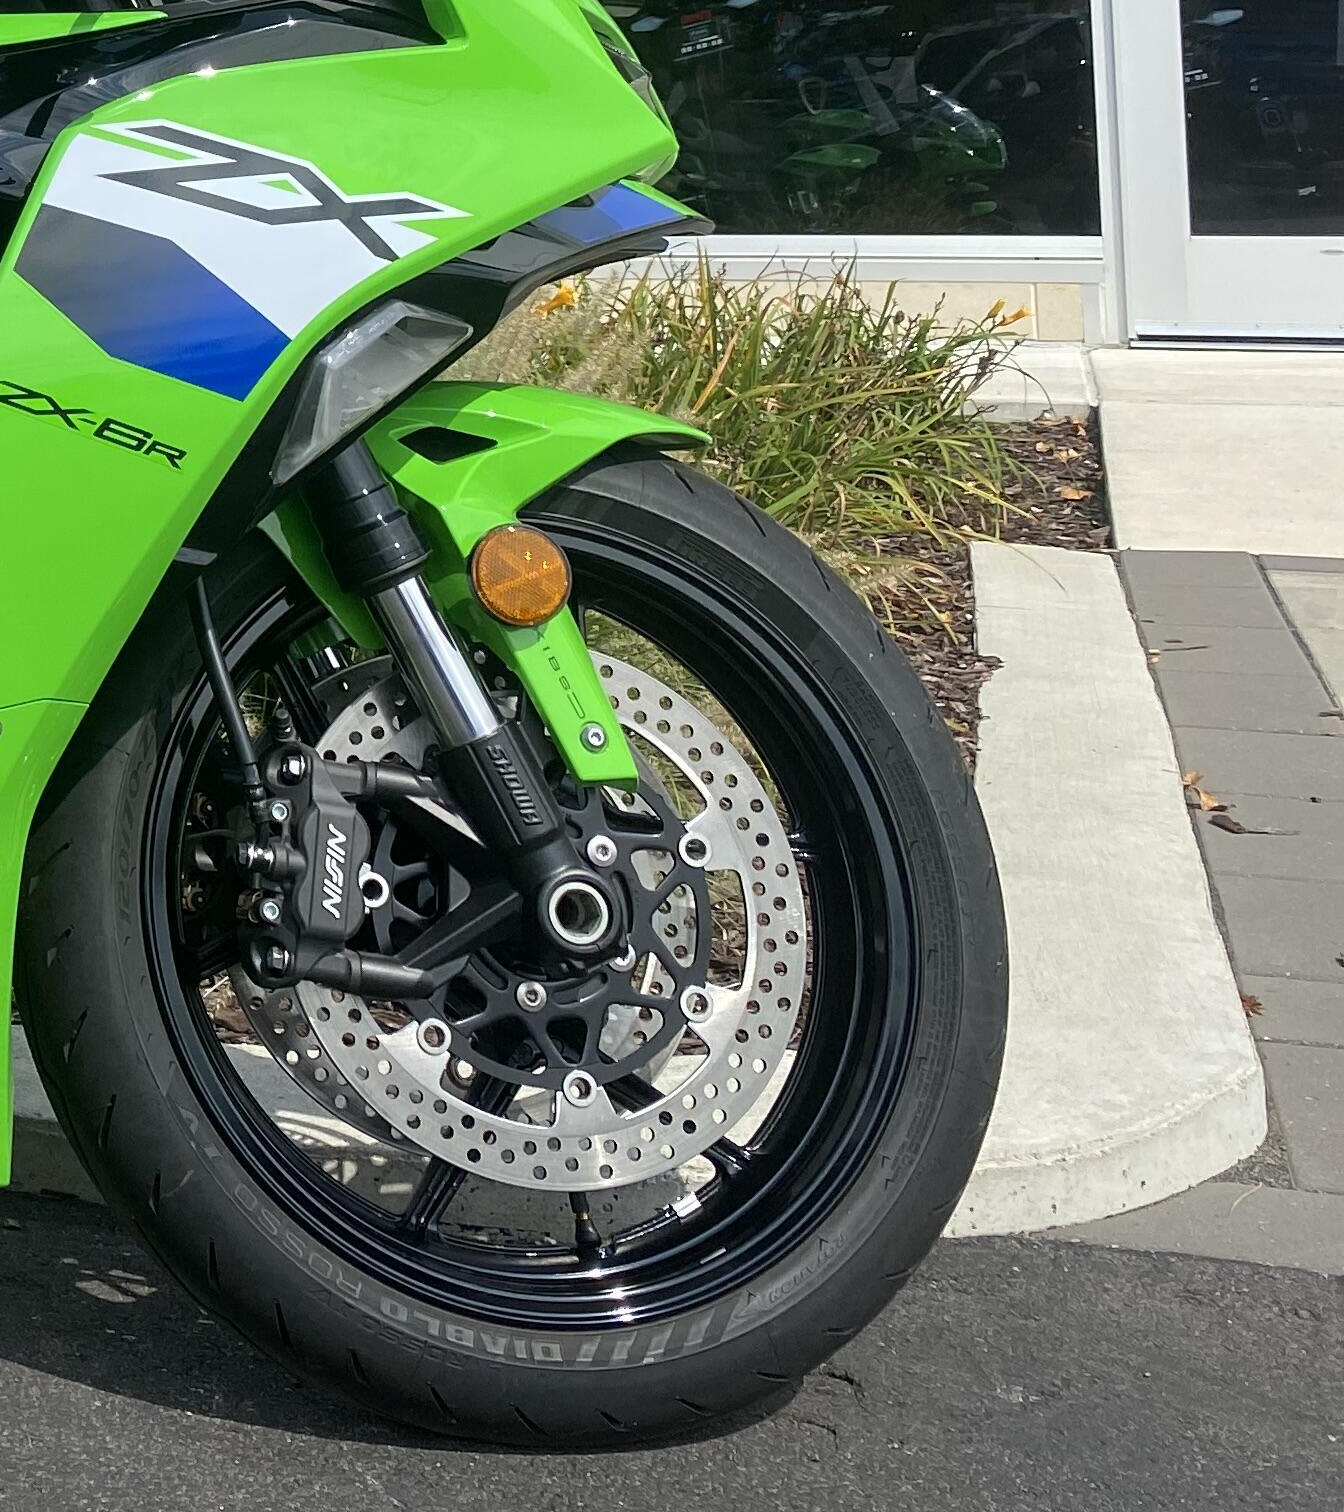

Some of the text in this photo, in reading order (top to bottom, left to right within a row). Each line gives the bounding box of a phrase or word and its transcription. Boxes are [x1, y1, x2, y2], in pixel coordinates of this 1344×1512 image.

[97, 124, 444, 262] ZX
[486, 744, 543, 825] SHOWA
[322, 823, 347, 919] NISSIN
[234, 1183, 363, 1300] ROSSO
[379, 1296, 564, 1363] DIABLO
